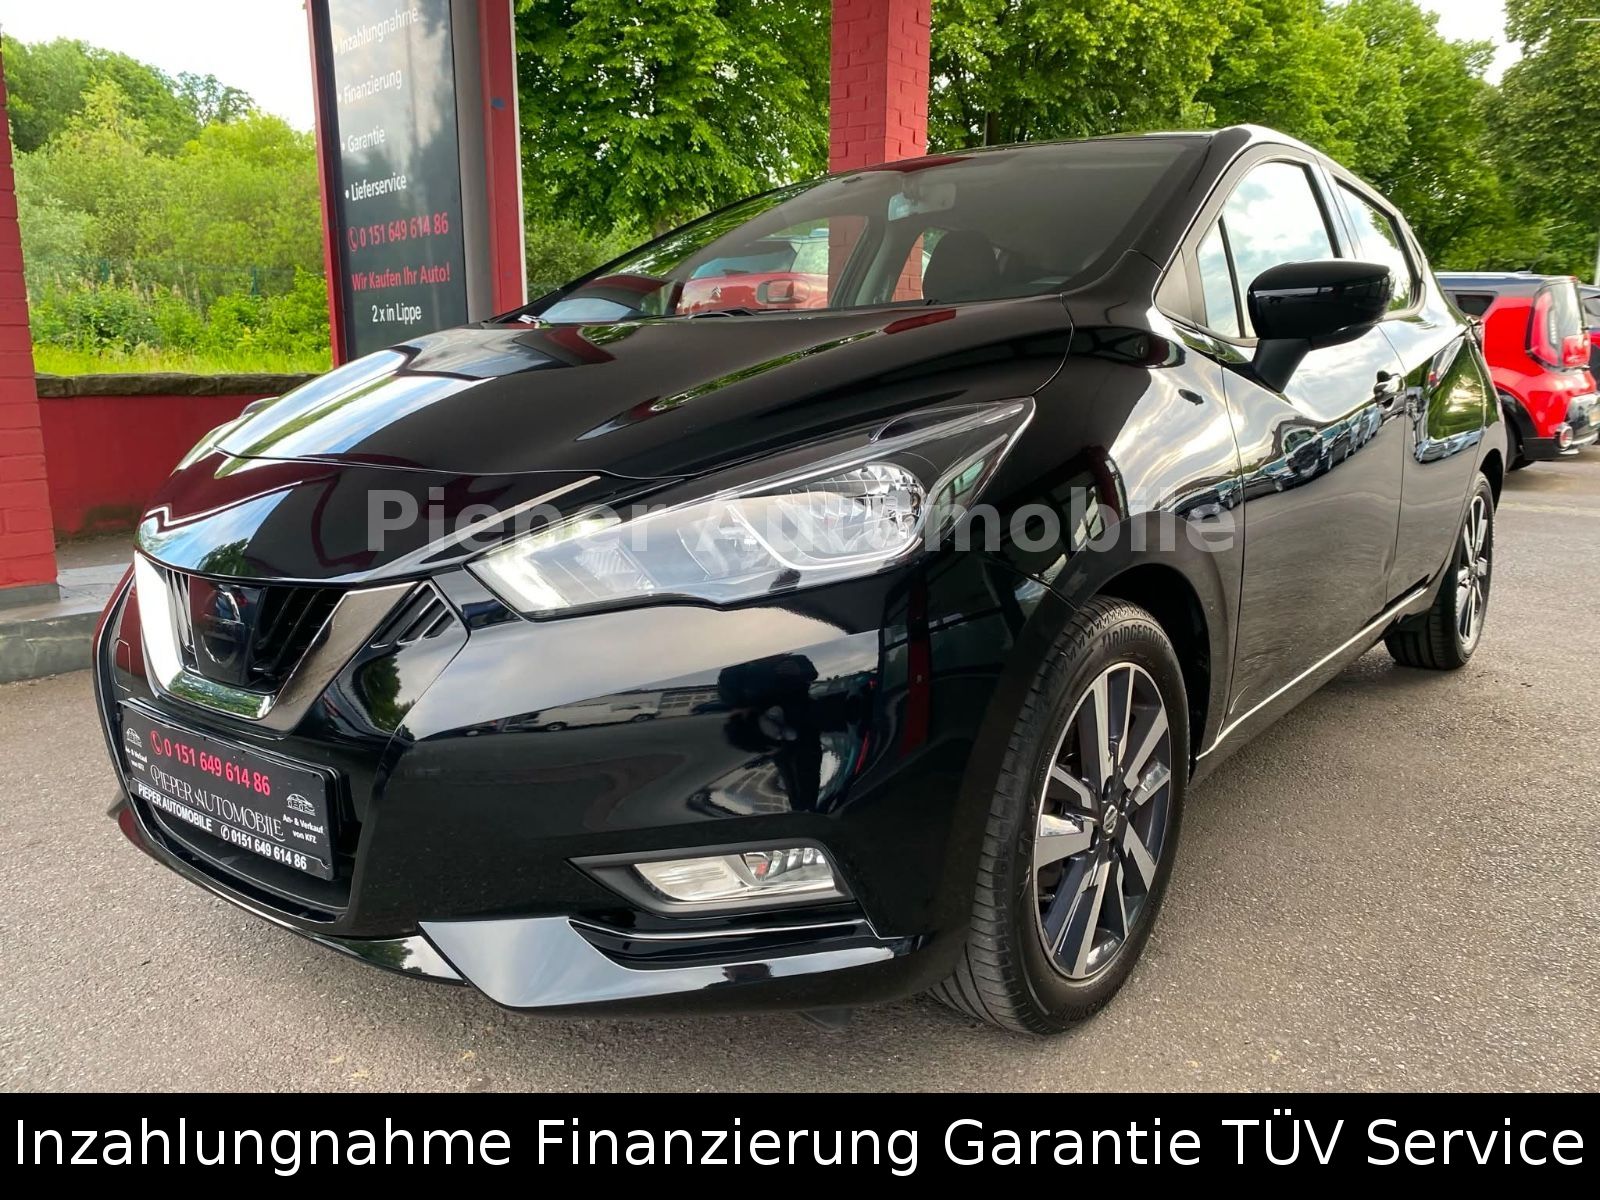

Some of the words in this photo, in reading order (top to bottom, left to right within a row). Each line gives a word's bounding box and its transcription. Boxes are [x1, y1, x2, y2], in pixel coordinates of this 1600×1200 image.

[340, 7, 419, 55] Inzahlungnahme
[343, 69, 402, 104] Finanzierung
[347, 125, 386, 152] Garantie
[351, 171, 407, 201] Lieferservice
[359, 227, 367, 248] 0
[369, 224, 386, 246] 151
[388, 219, 408, 243] 649
[410, 215, 431, 239] 614
[433, 211, 449, 235] 86
[352, 271, 368, 291] Wir
[369, 267, 401, 289] Kaufen
[403, 265, 417, 285] Ihr
[420, 261, 450, 284] Auto!
[371, 304, 378, 323] 2
[379, 308, 386, 322] x
[386, 303, 395, 321] in
[396, 302, 422, 325] Lippe
[164, 738, 172, 757] 0
[174, 743, 196, 767] 151
[200, 751, 222, 777] 649
[225, 761, 250, 789] 614
[253, 772, 271, 796] 86
[138, 783, 162, 807] PIEPER
[162, 797, 213, 833] AUTOMOBILE
[150, 764, 194, 804] PIEPER
[194, 788, 286, 842] AUTOMOBILE
[231, 829, 252, 849] 0151
[254, 838, 272, 857] 649
[273, 846, 292, 865] 614
[294, 853, 307, 870] 86
